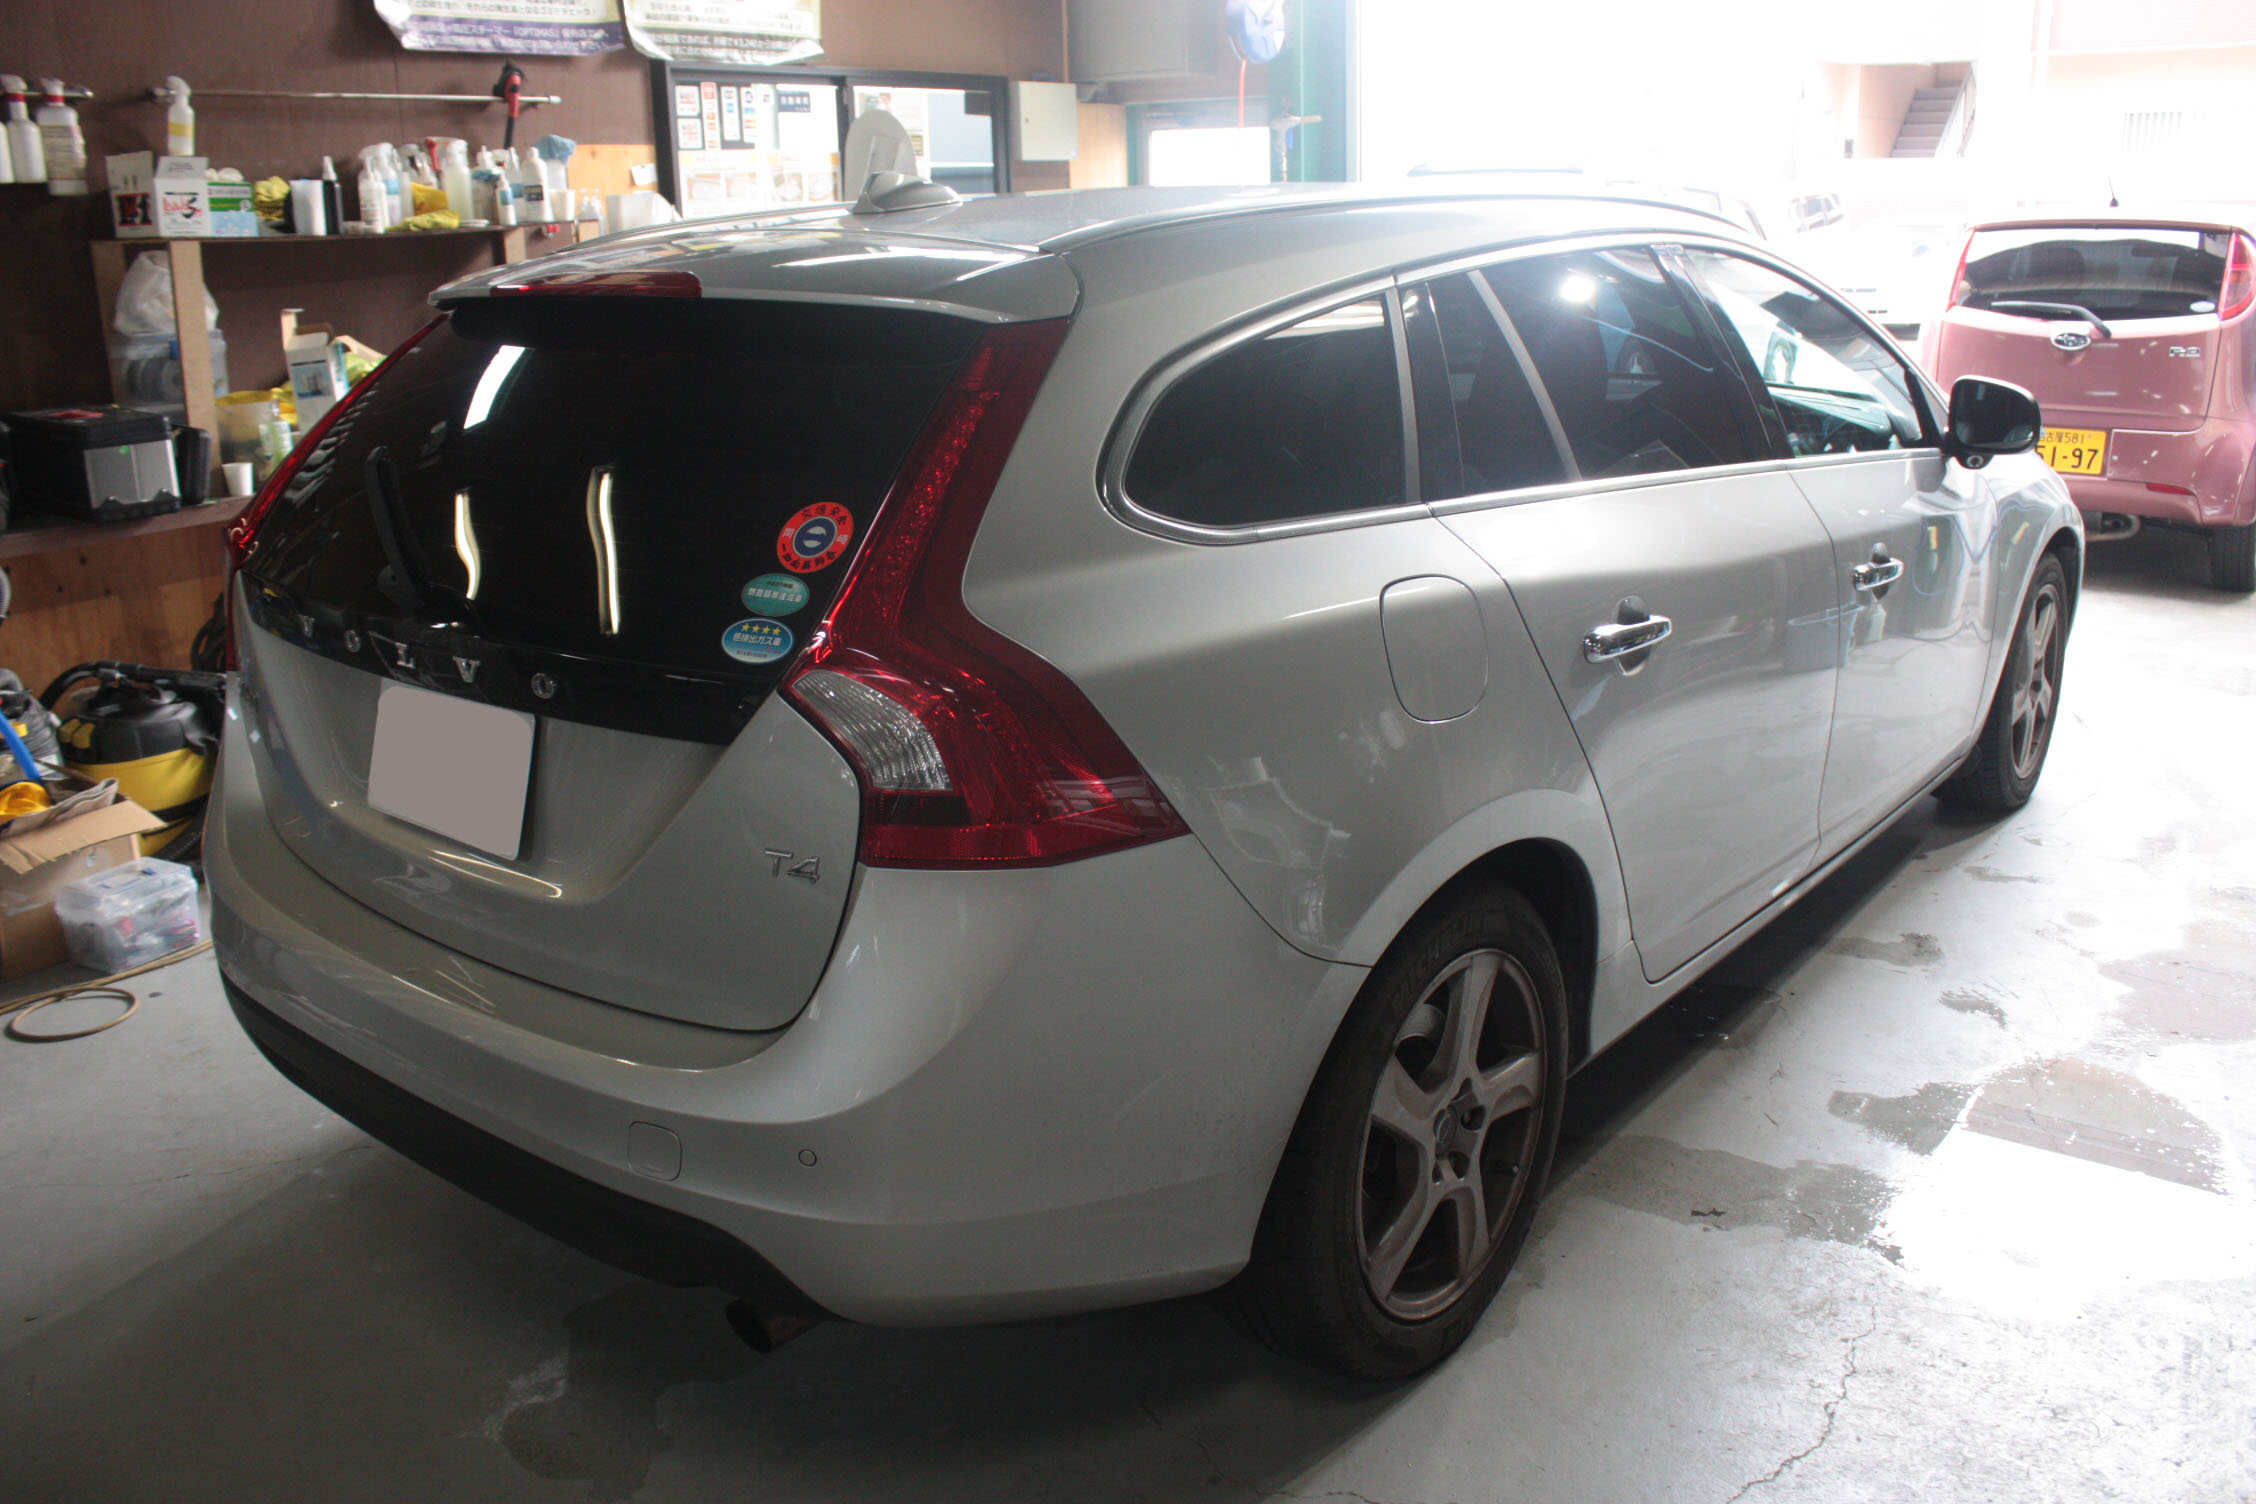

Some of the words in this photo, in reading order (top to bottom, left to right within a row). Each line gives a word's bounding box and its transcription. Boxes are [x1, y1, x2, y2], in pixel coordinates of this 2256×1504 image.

[2168, 346, 2201, 358] R2
[733, 632, 783, 647] 低排出ガス車
[299, 615, 557, 699] VOLVO
[763, 848, 821, 885] T4
